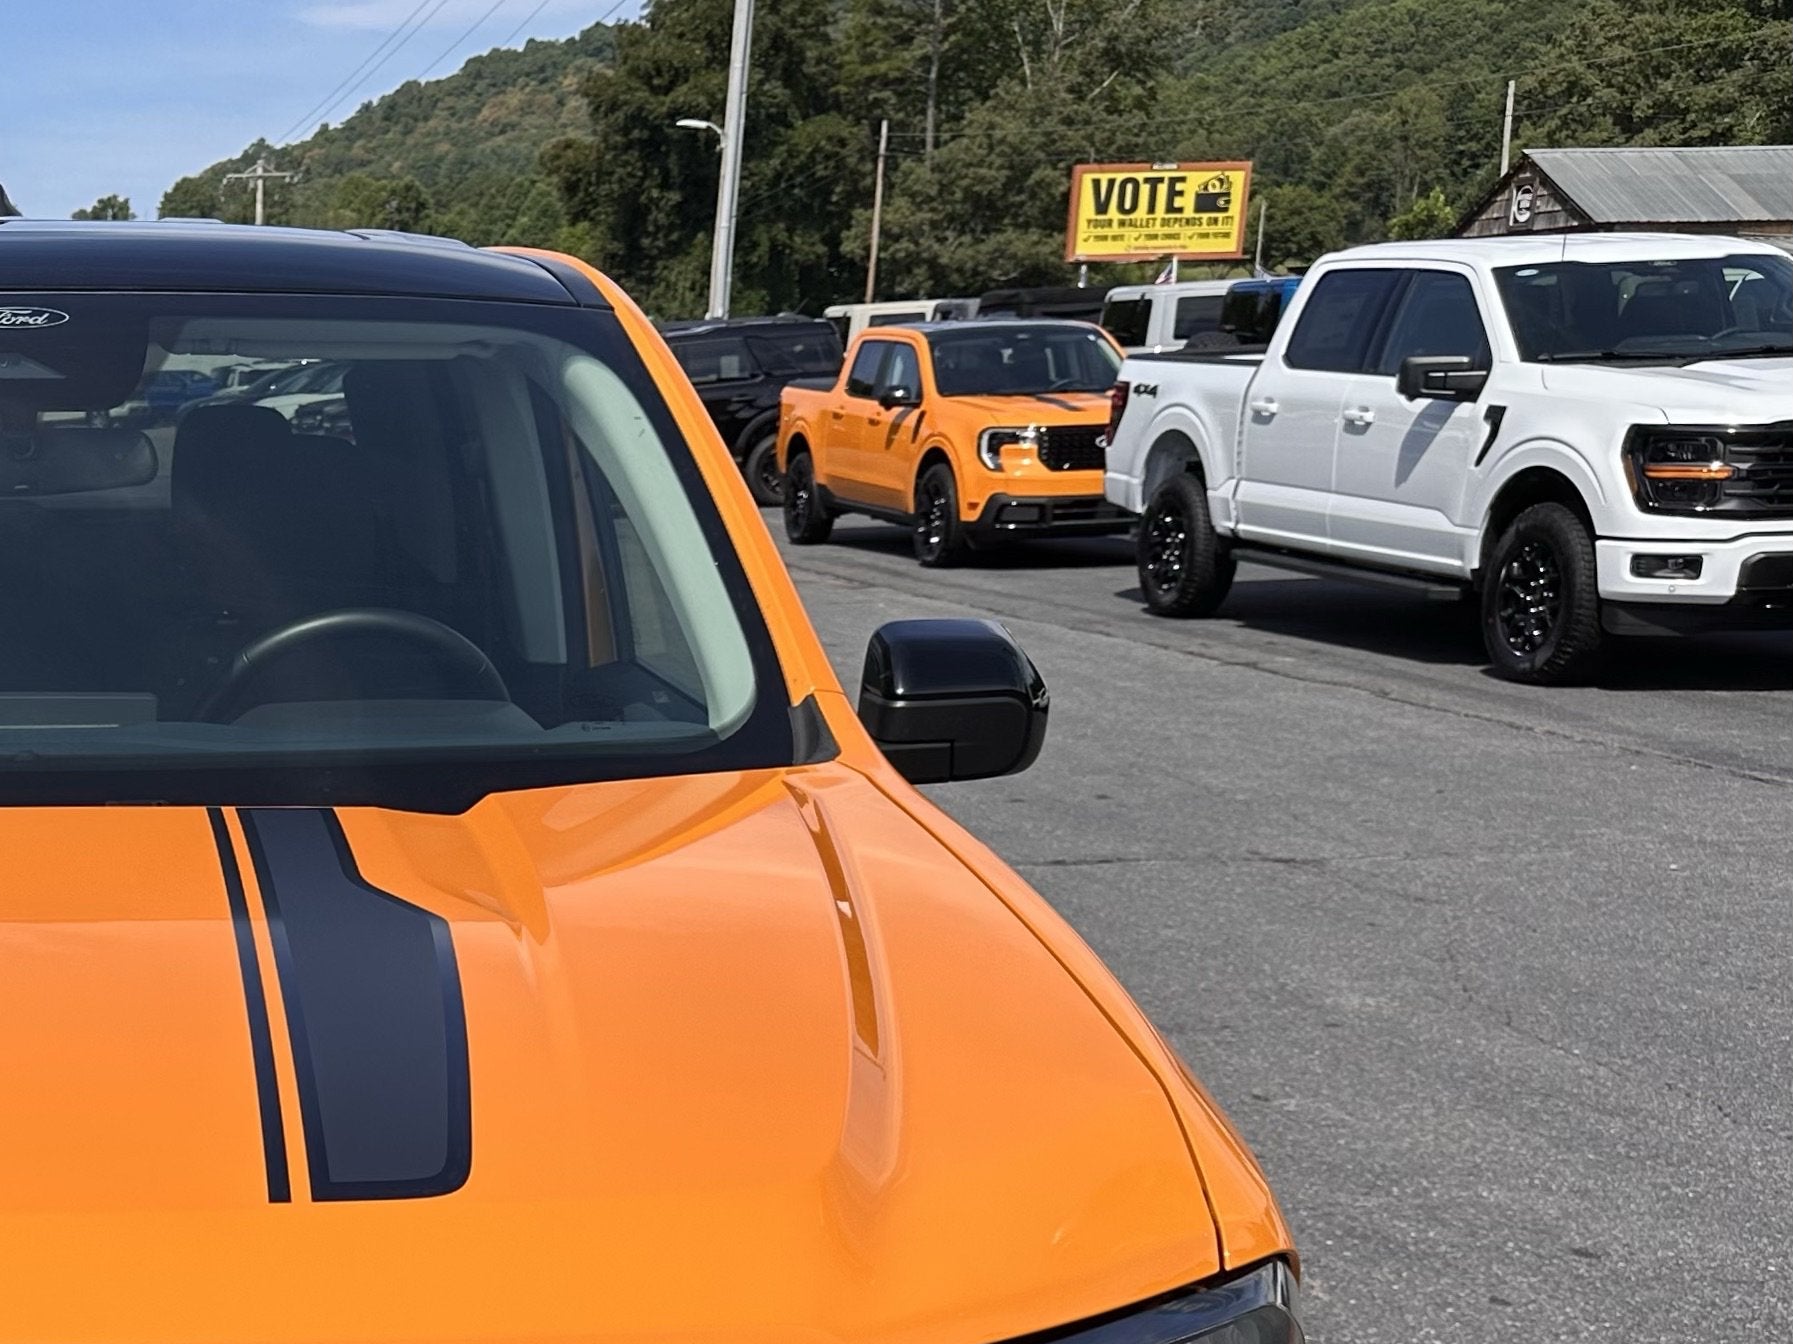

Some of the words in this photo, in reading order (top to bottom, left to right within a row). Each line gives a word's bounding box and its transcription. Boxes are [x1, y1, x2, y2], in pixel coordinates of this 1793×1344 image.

[1091, 176, 1187, 216] VOTE
[1086, 217, 1113, 229] YOUR
[1117, 217, 1157, 229] WALLET
[1160, 216, 1203, 228] DEPENDS
[1206, 216, 1219, 227] ON
